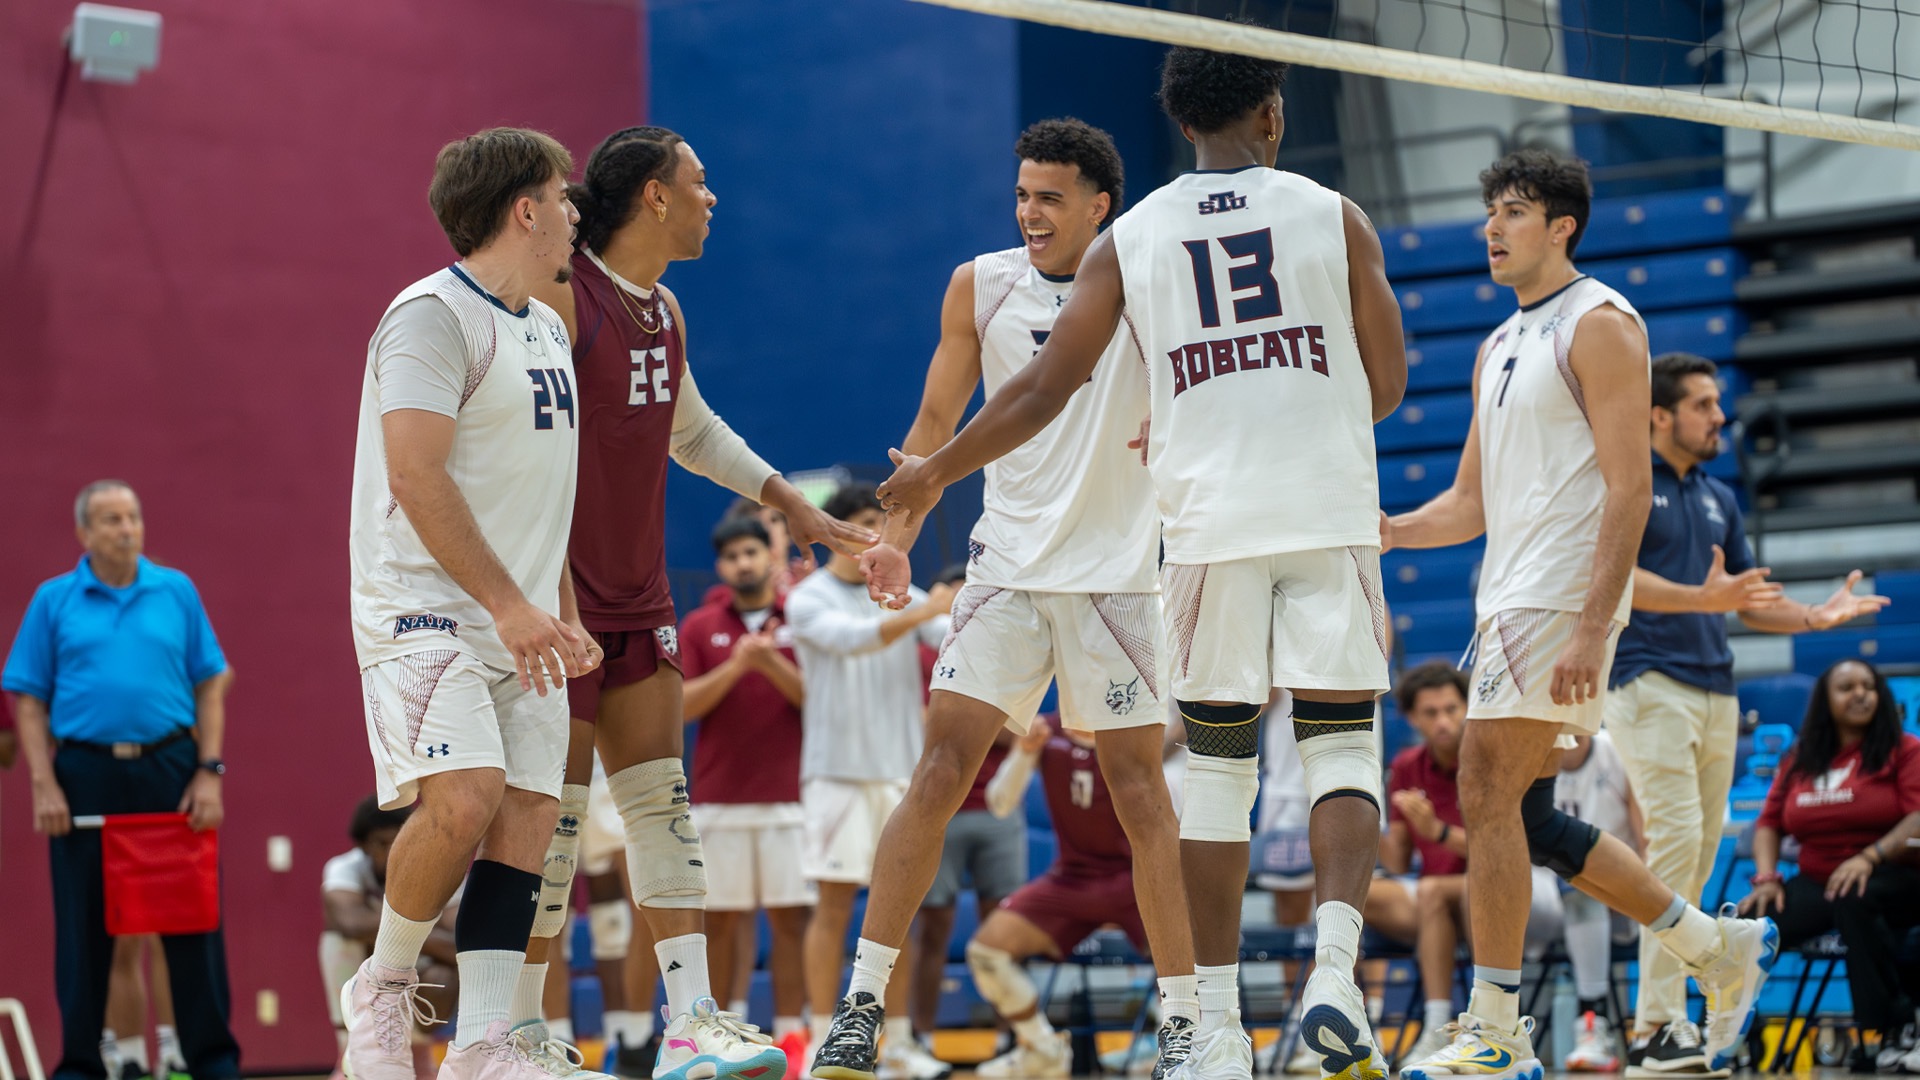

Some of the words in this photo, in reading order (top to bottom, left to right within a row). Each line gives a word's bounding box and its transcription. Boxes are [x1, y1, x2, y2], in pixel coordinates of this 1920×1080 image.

[1182, 227, 1283, 328] 13
[628, 346, 672, 405] 22
[1167, 325, 1329, 399] BOBCATS
[1496, 356, 1519, 408] 7
[526, 368, 575, 430] 24
[394, 613, 458, 639] NAIA
